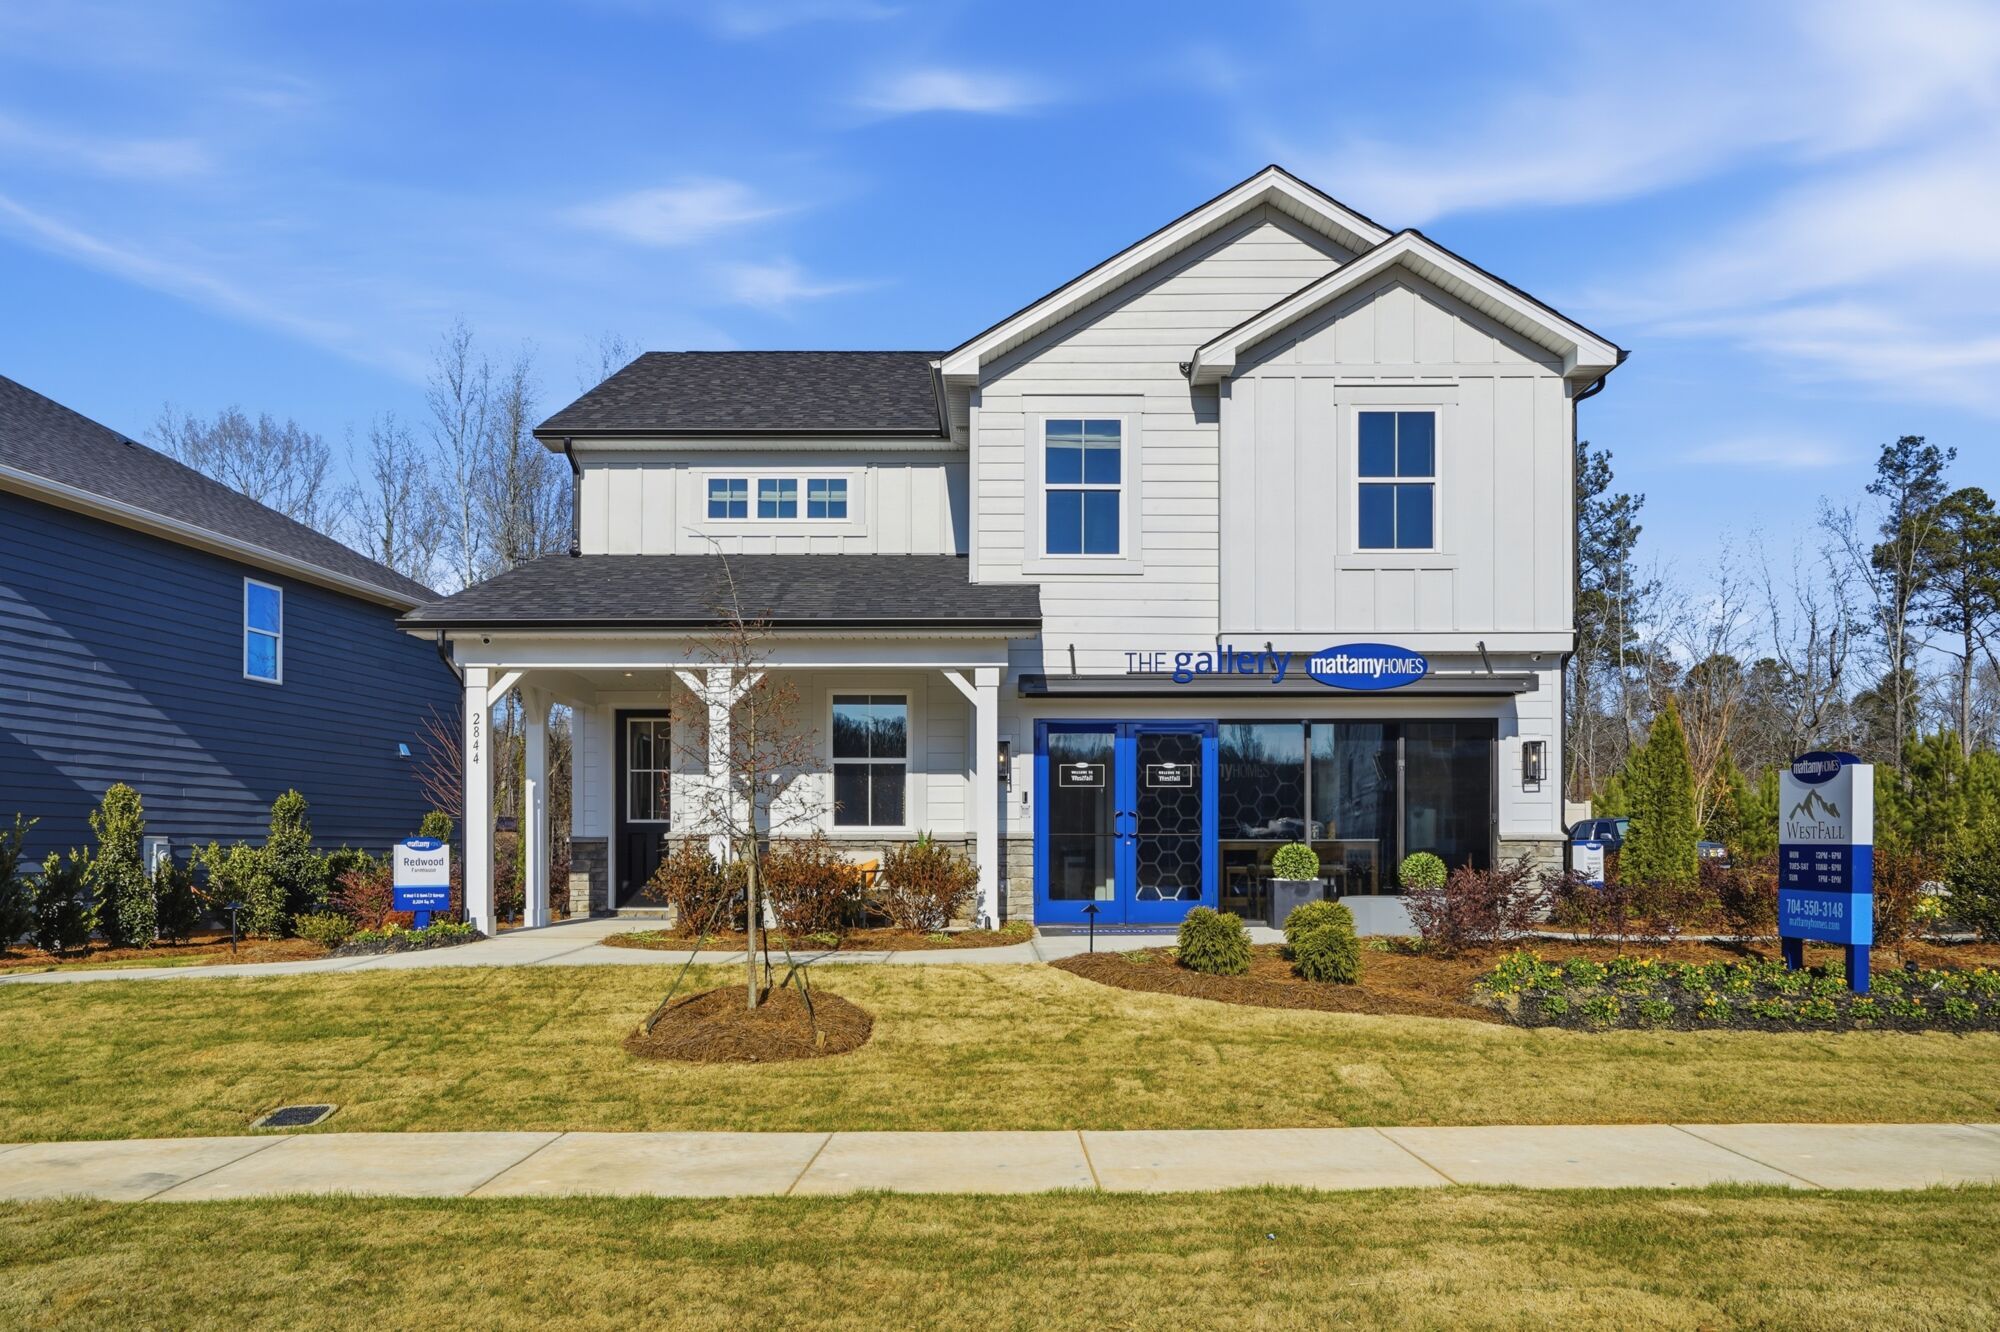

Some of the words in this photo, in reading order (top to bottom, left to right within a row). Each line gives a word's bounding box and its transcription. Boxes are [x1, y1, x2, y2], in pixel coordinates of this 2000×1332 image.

[1124, 652, 1167, 672] THE
[1172, 645, 1292, 684] gallery
[1311, 654, 1424, 678] mattamyHOMES
[403, 857, 444, 867] Redwood
[1786, 898, 1844, 918] 704-550-3148
